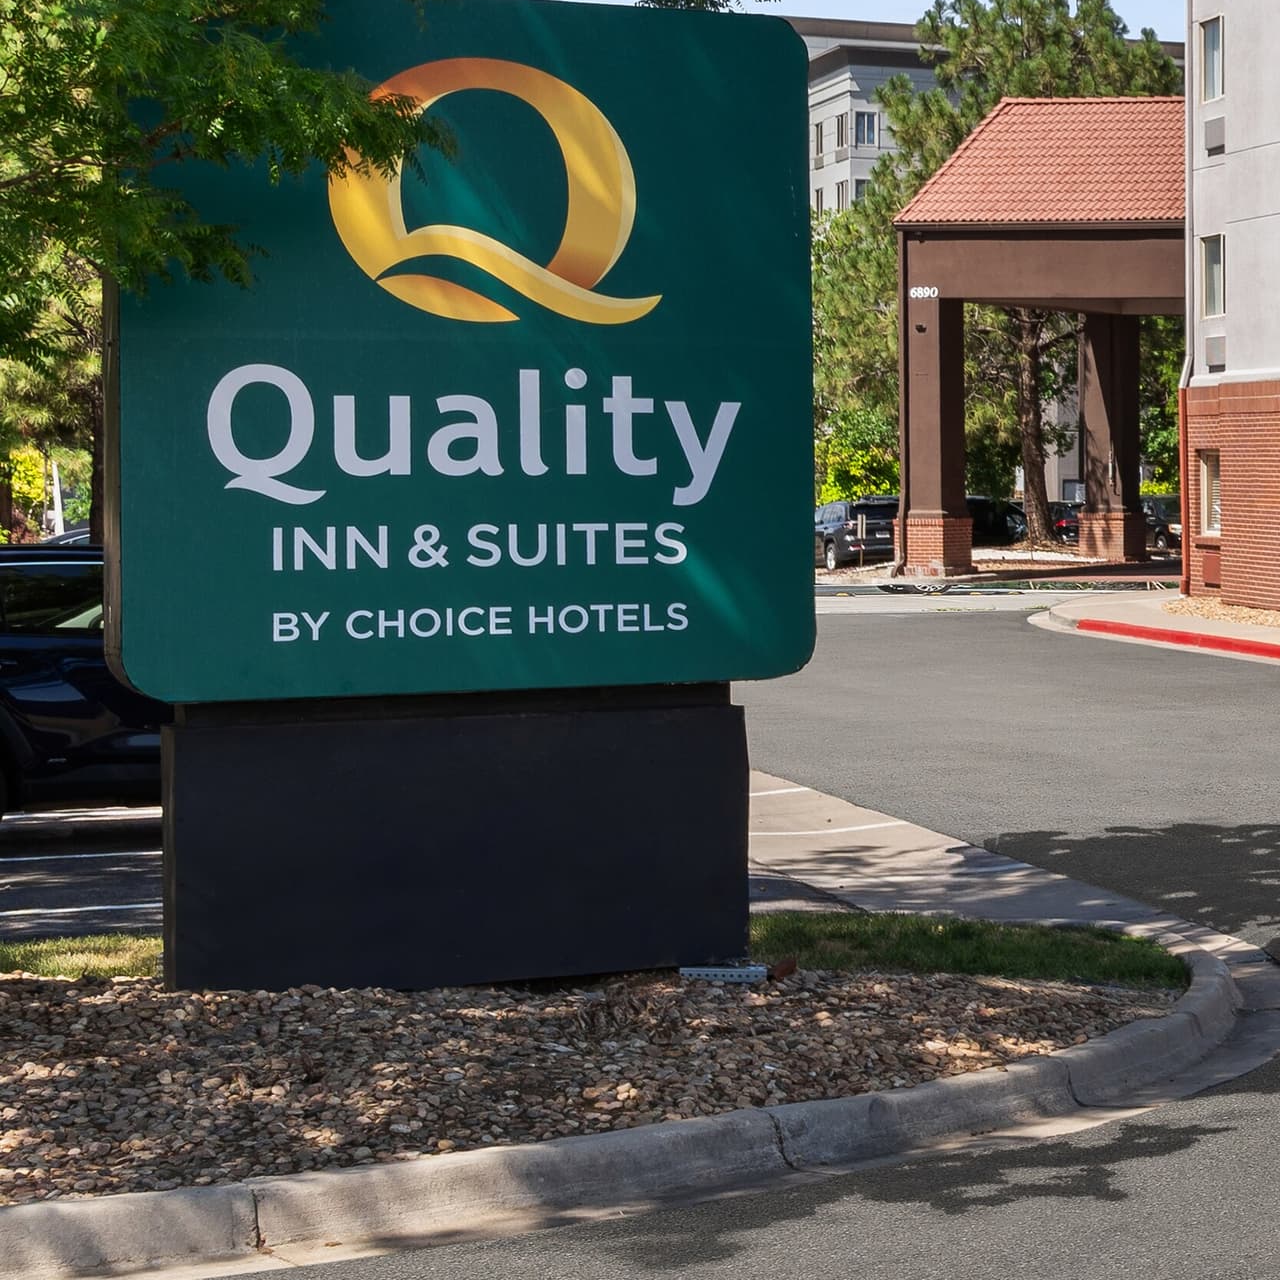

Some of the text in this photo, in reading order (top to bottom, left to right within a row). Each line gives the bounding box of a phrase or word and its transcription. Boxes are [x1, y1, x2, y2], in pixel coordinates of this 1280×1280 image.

[328, 57, 663, 324] Q
[910, 286, 939, 298] 6890
[206, 363, 741, 506] Quality
[273, 522, 688, 571] INN & SUITES
[273, 602, 689, 642] BY CHOICE HOTELS
